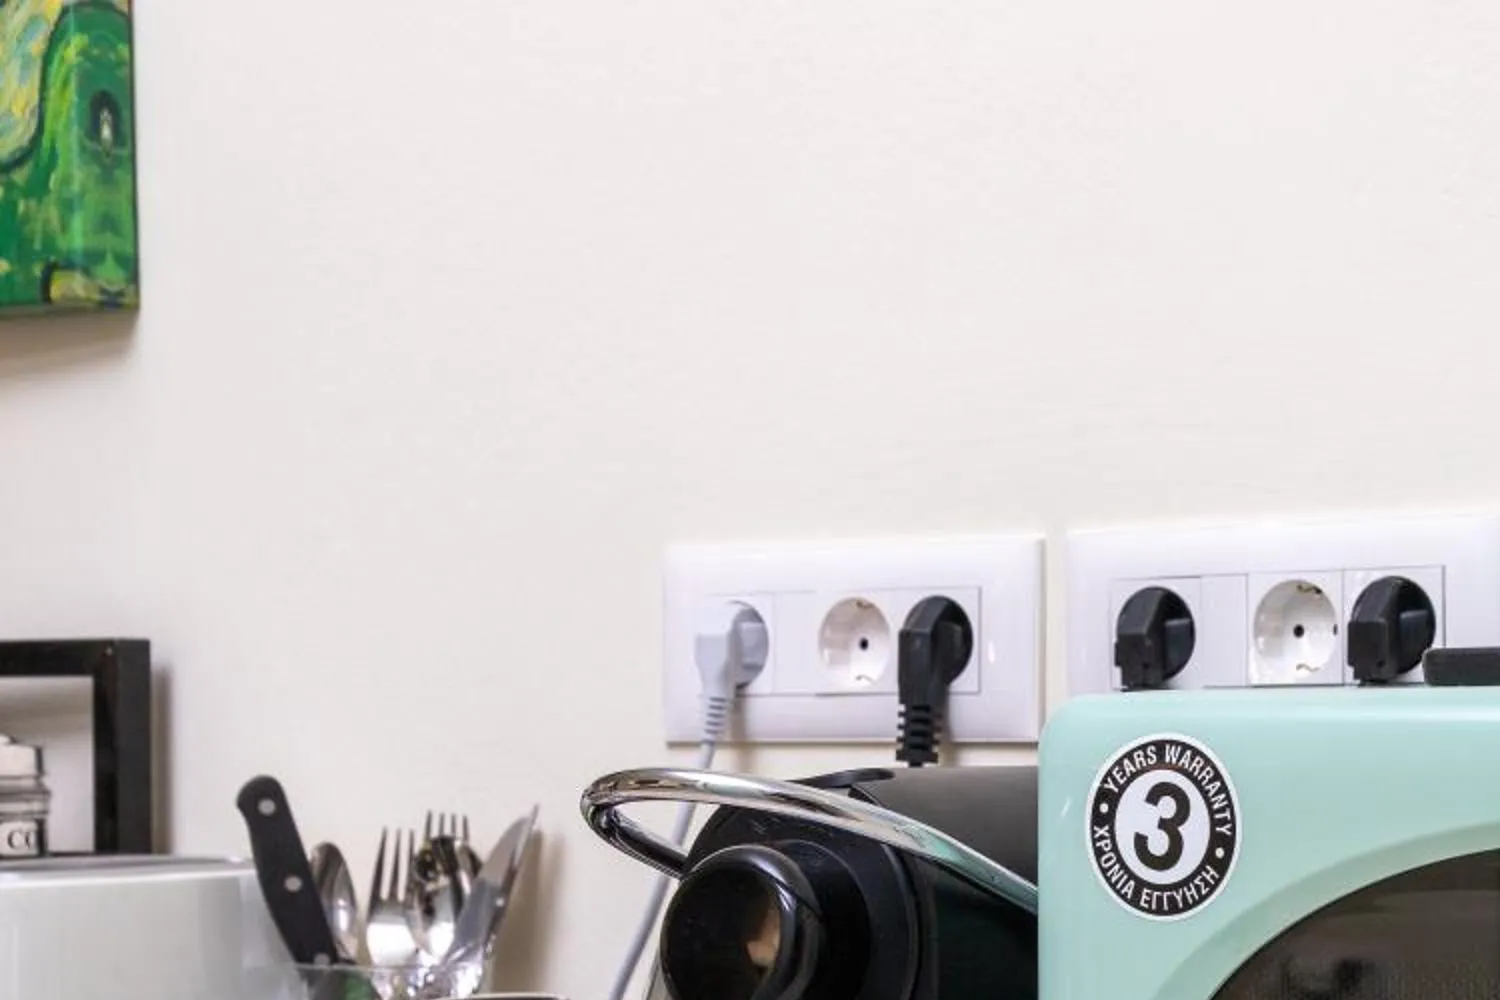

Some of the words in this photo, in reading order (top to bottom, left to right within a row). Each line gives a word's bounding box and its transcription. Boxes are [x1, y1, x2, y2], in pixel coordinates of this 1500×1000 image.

[1103, 745, 1157, 794] YEARS
[1165, 744, 1233, 836] WARRANTY
[1133, 781, 1191, 871] 3
